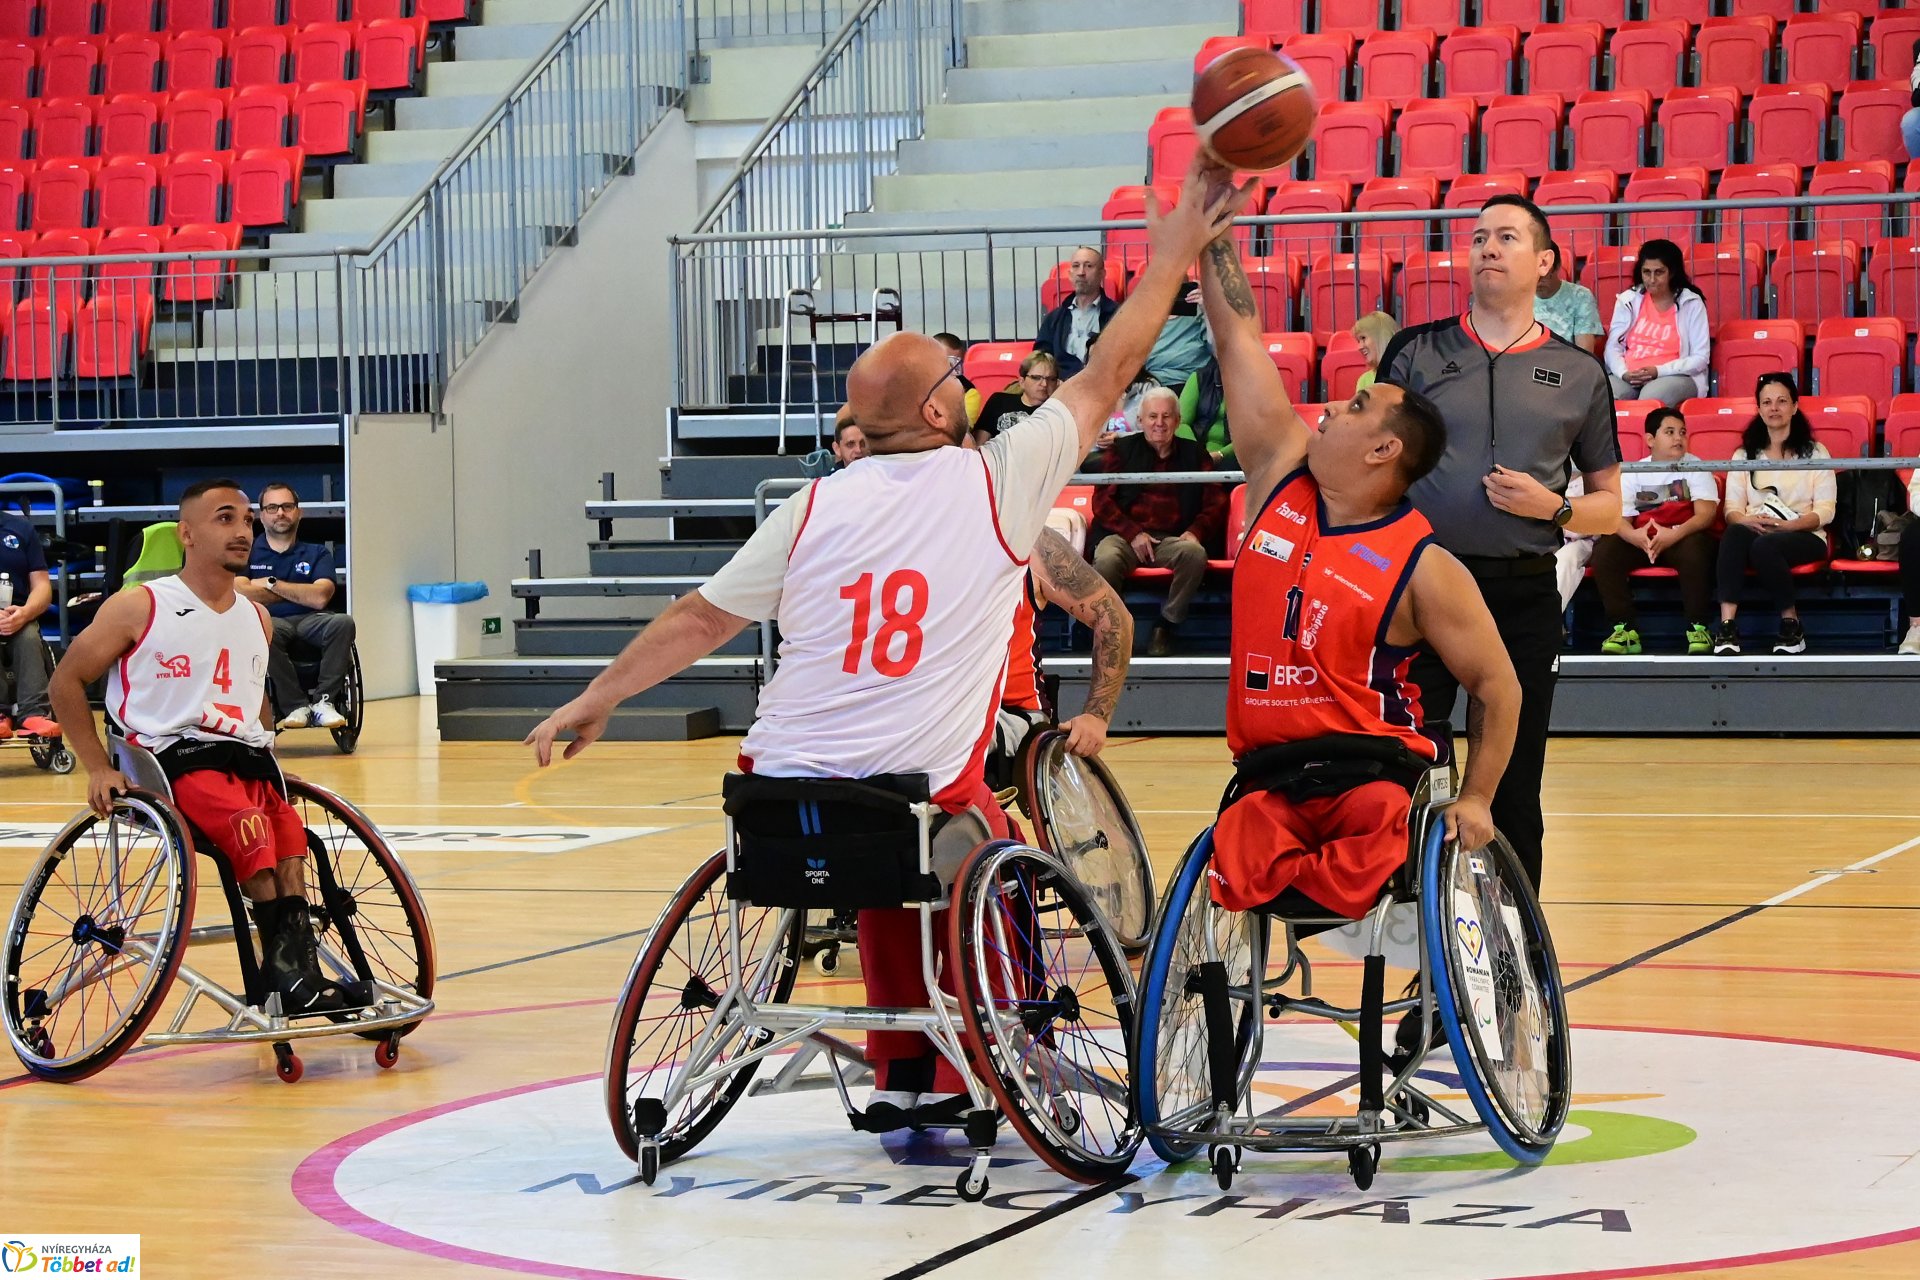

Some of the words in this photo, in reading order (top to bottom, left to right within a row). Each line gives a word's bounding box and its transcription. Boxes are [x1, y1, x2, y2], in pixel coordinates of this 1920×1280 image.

[1333, 573, 1375, 603] wienerberger
[839, 568, 930, 678] 18
[212, 648, 233, 695] 4
[1244, 697, 1271, 707] GROUPE
[1299, 695, 1340, 706] GENERAL
[804, 870, 830, 878] SPORTA
[811, 877, 825, 885] ONE
